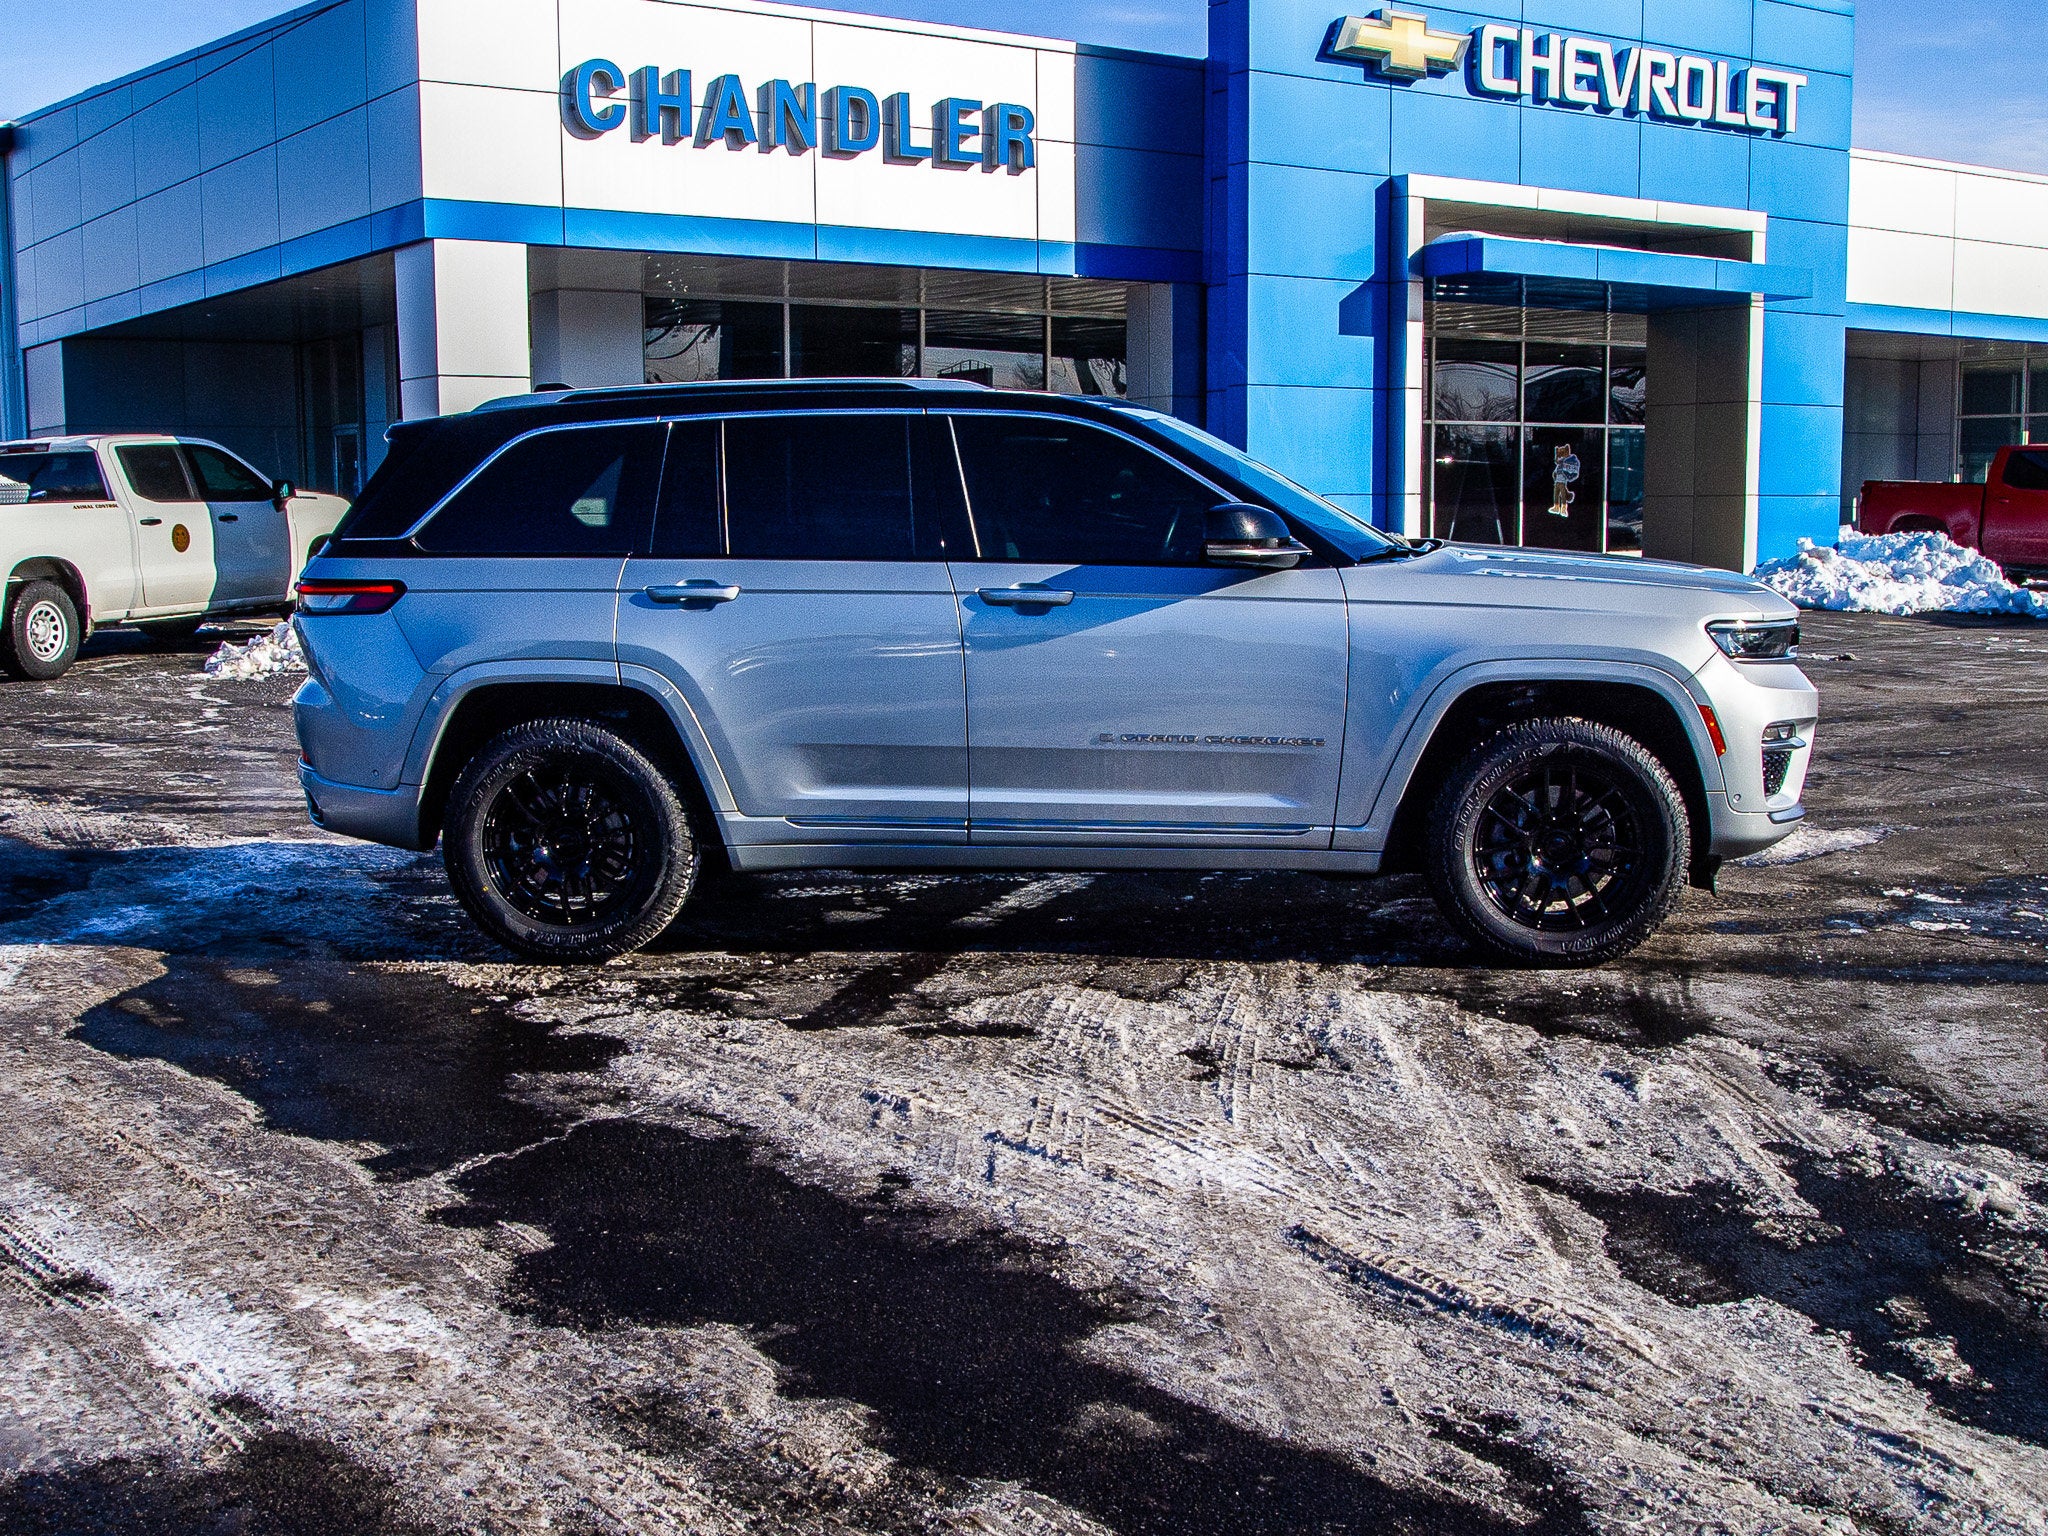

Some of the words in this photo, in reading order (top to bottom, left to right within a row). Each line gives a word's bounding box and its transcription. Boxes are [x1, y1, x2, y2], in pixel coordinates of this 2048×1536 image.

[560, 58, 1036, 175] CHANDLER
[1473, 23, 1808, 138] CHEVROLET
[1120, 733, 1199, 744] GRAND
[1204, 735, 1325, 747] CHEROKEE
